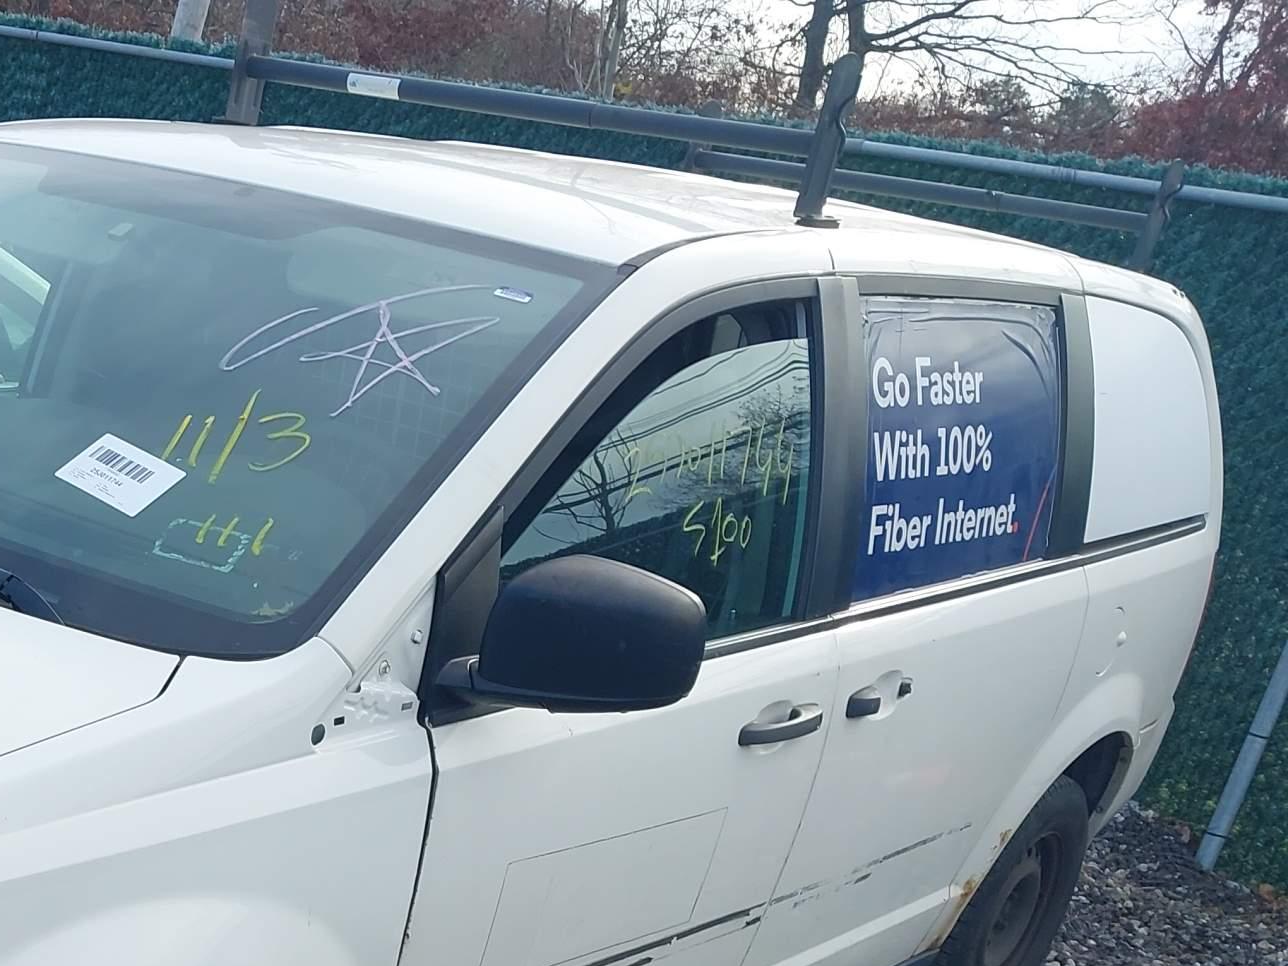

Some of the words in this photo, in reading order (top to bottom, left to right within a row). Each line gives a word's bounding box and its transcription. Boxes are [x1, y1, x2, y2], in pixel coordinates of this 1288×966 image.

[872, 357, 910, 408] Go
[915, 357, 984, 406] Faster
[161, 388, 312, 485] 11/3
[873, 429, 930, 482] With
[936, 424, 993, 477] 100%
[867, 503, 932, 555] Fiber
[934, 493, 1019, 545] Internet.
